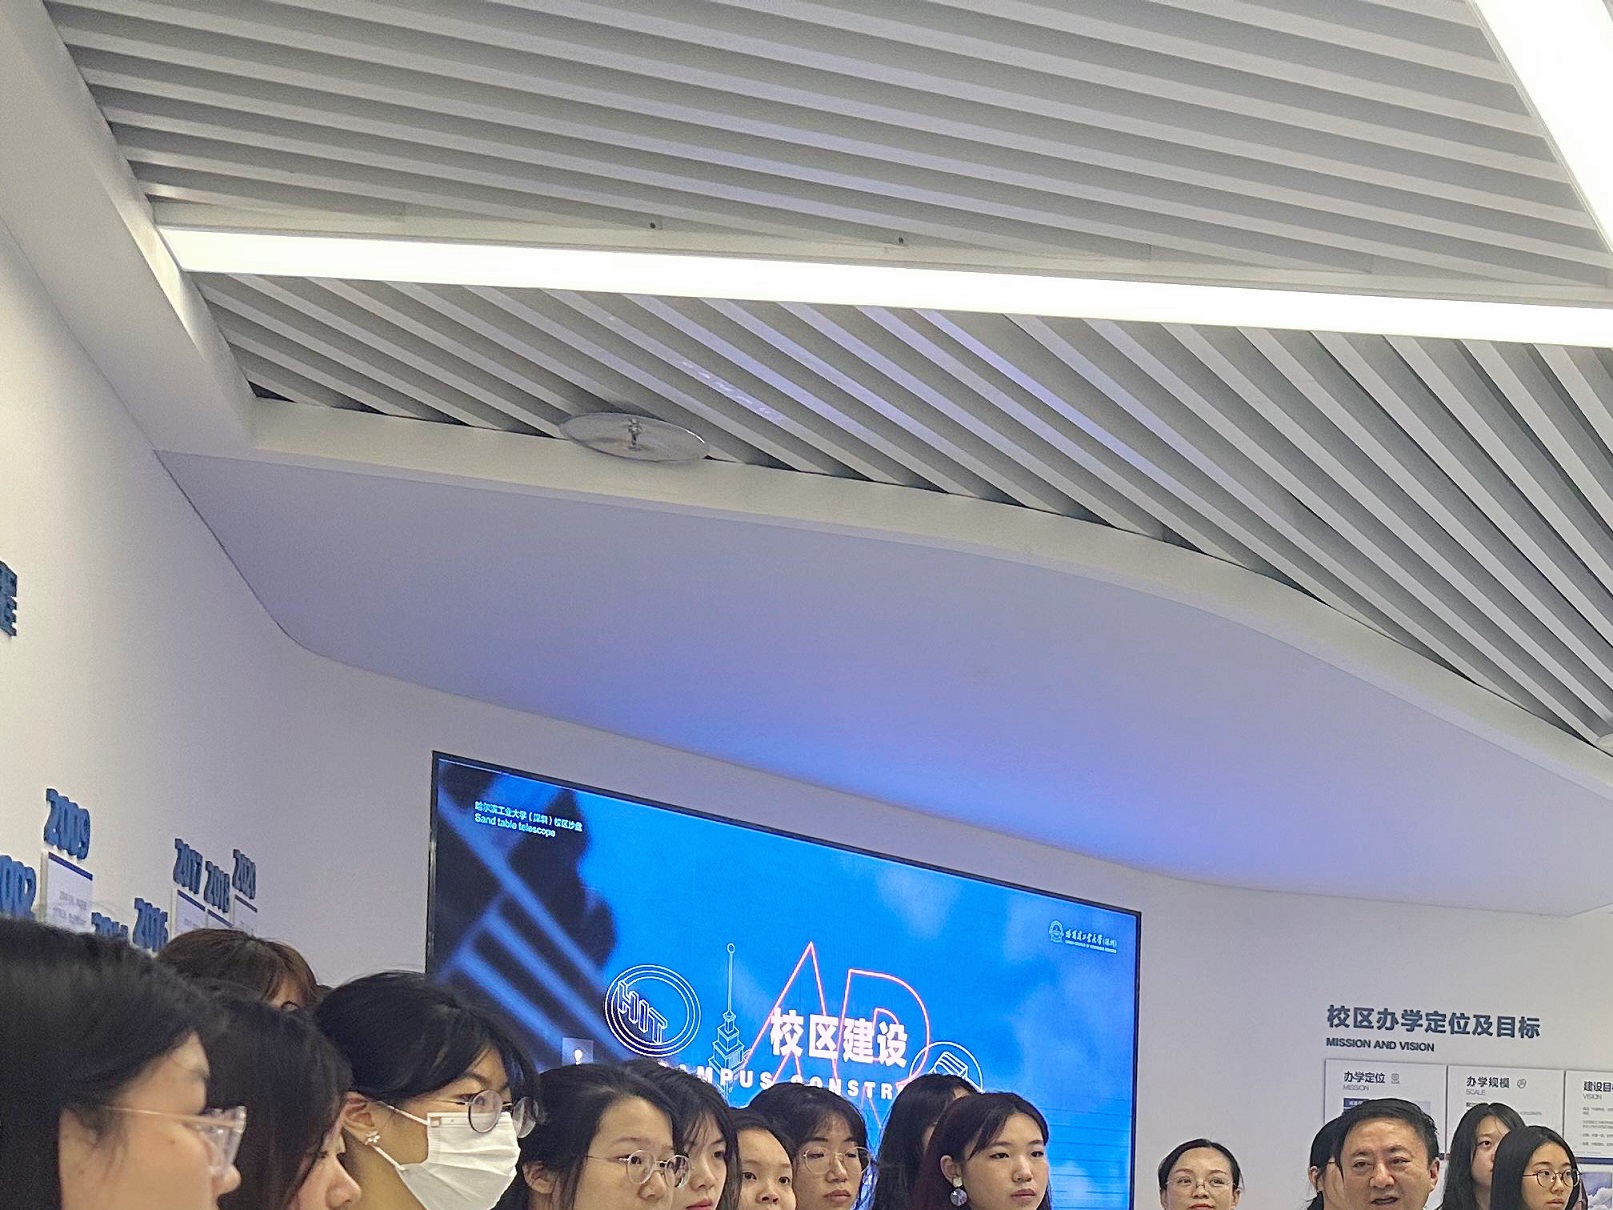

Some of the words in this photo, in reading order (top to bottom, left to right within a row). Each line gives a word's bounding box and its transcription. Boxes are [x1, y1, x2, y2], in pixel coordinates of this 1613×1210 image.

[474, 813, 497, 825] Sand
[497, 817, 518, 830] table
[518, 822, 556, 838] telescope
[617, 980, 668, 1045] HIT
[1327, 1004, 1541, 1039] 校区办学定位及目标
[770, 1007, 909, 1068] 校区建设
[1326, 1037, 1371, 1049] MISSION
[1373, 1039, 1397, 1050] AND
[1399, 1041, 1435, 1052] VISION
[1343, 1071, 1386, 1084] 办学定位
[1465, 1088, 1486, 1096] SCALE
